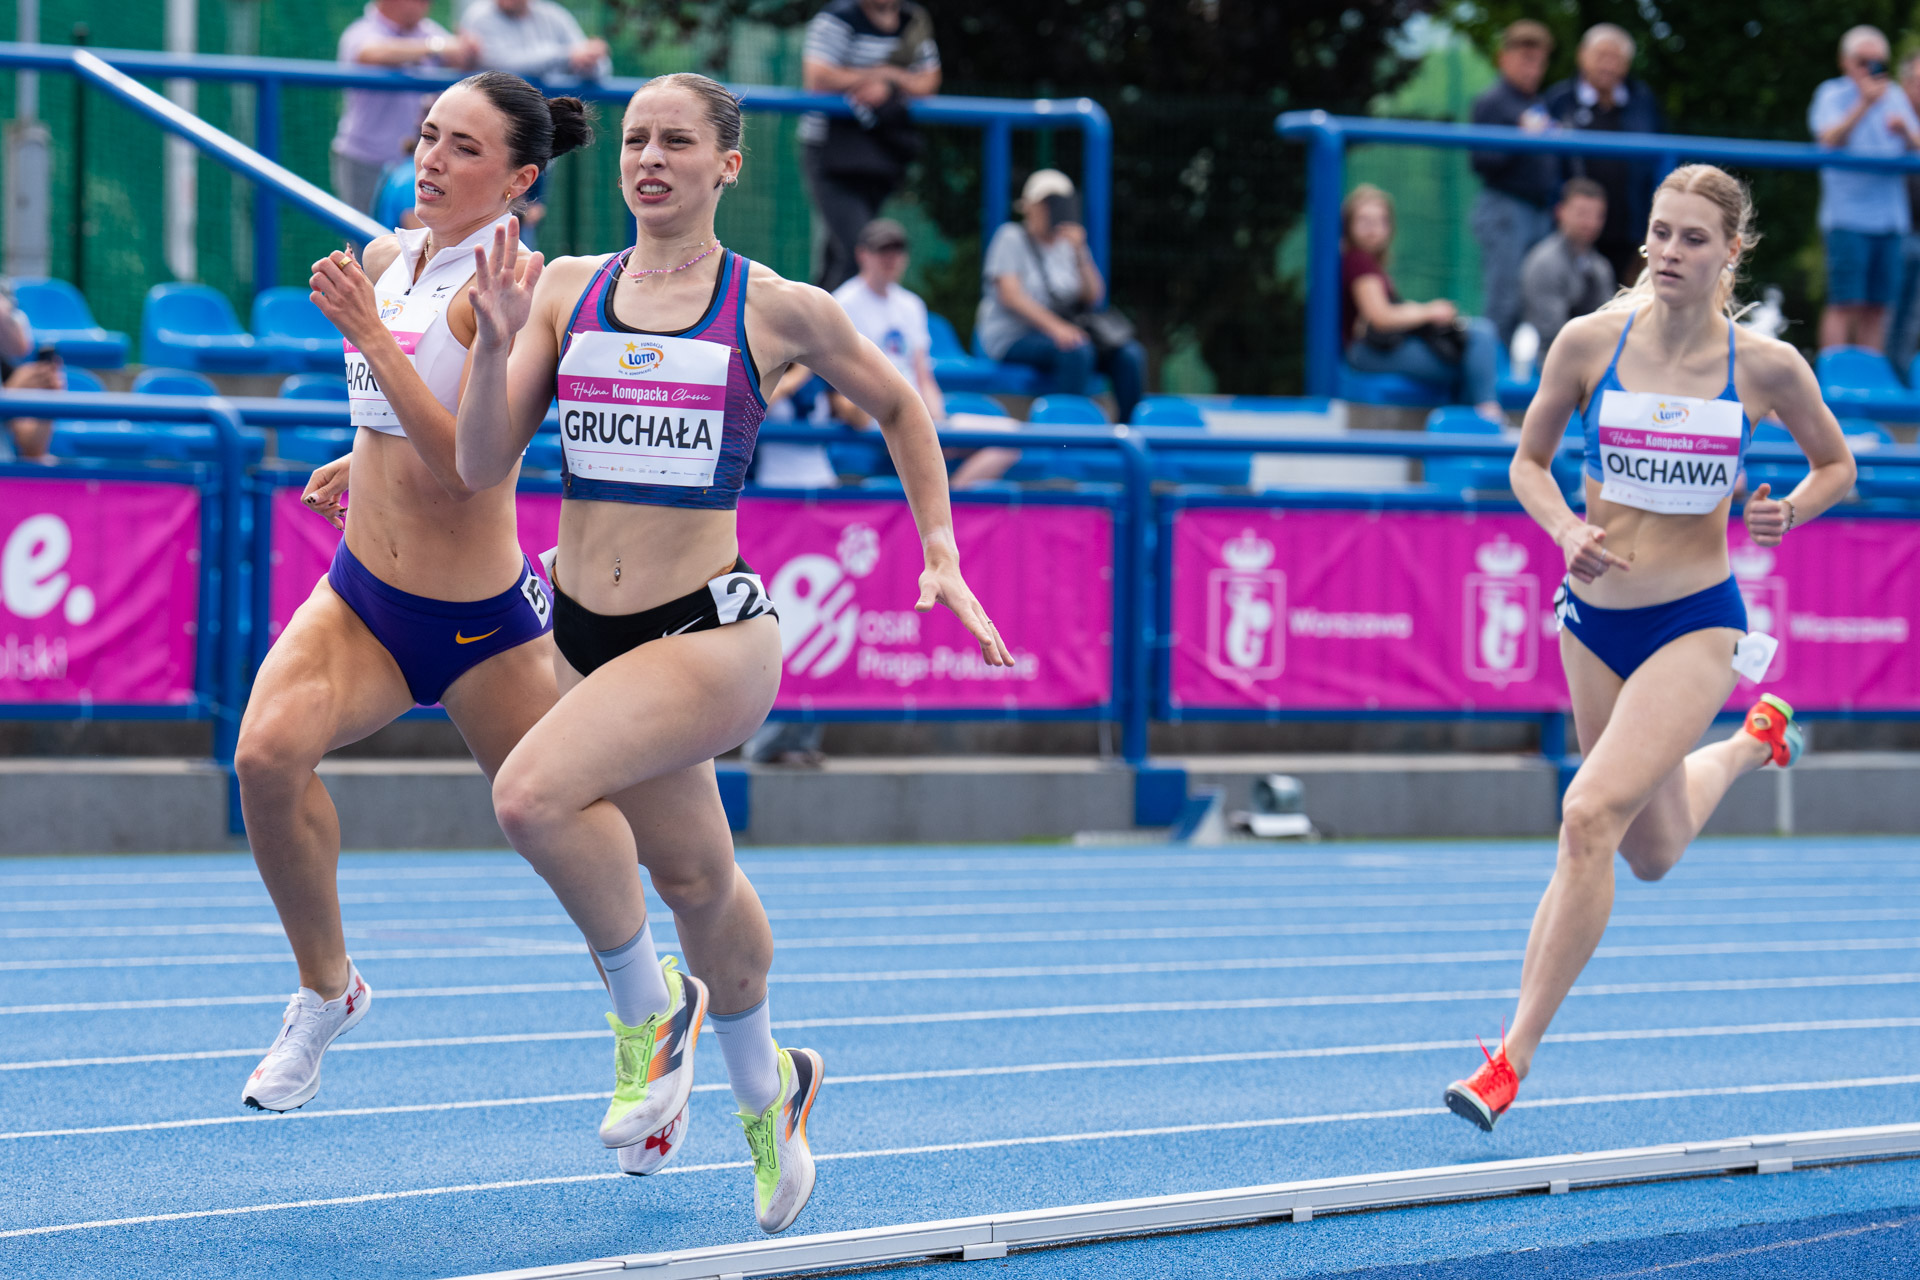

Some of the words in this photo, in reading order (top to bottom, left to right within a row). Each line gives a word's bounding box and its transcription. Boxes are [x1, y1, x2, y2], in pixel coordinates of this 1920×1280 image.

[628, 352, 656, 366] LOTTO
[345, 362, 379, 391] ARR
[570, 382, 609, 399] Halina
[612, 383, 669, 403] Konopacka
[671, 388, 711, 401] Classic
[565, 410, 713, 450] GRUCHAŁA
[1645, 433, 1694, 451] Konopacka
[1607, 453, 1728, 486] OLCHAWA
[527, 578, 546, 615] 5
[726, 576, 764, 622] 2
